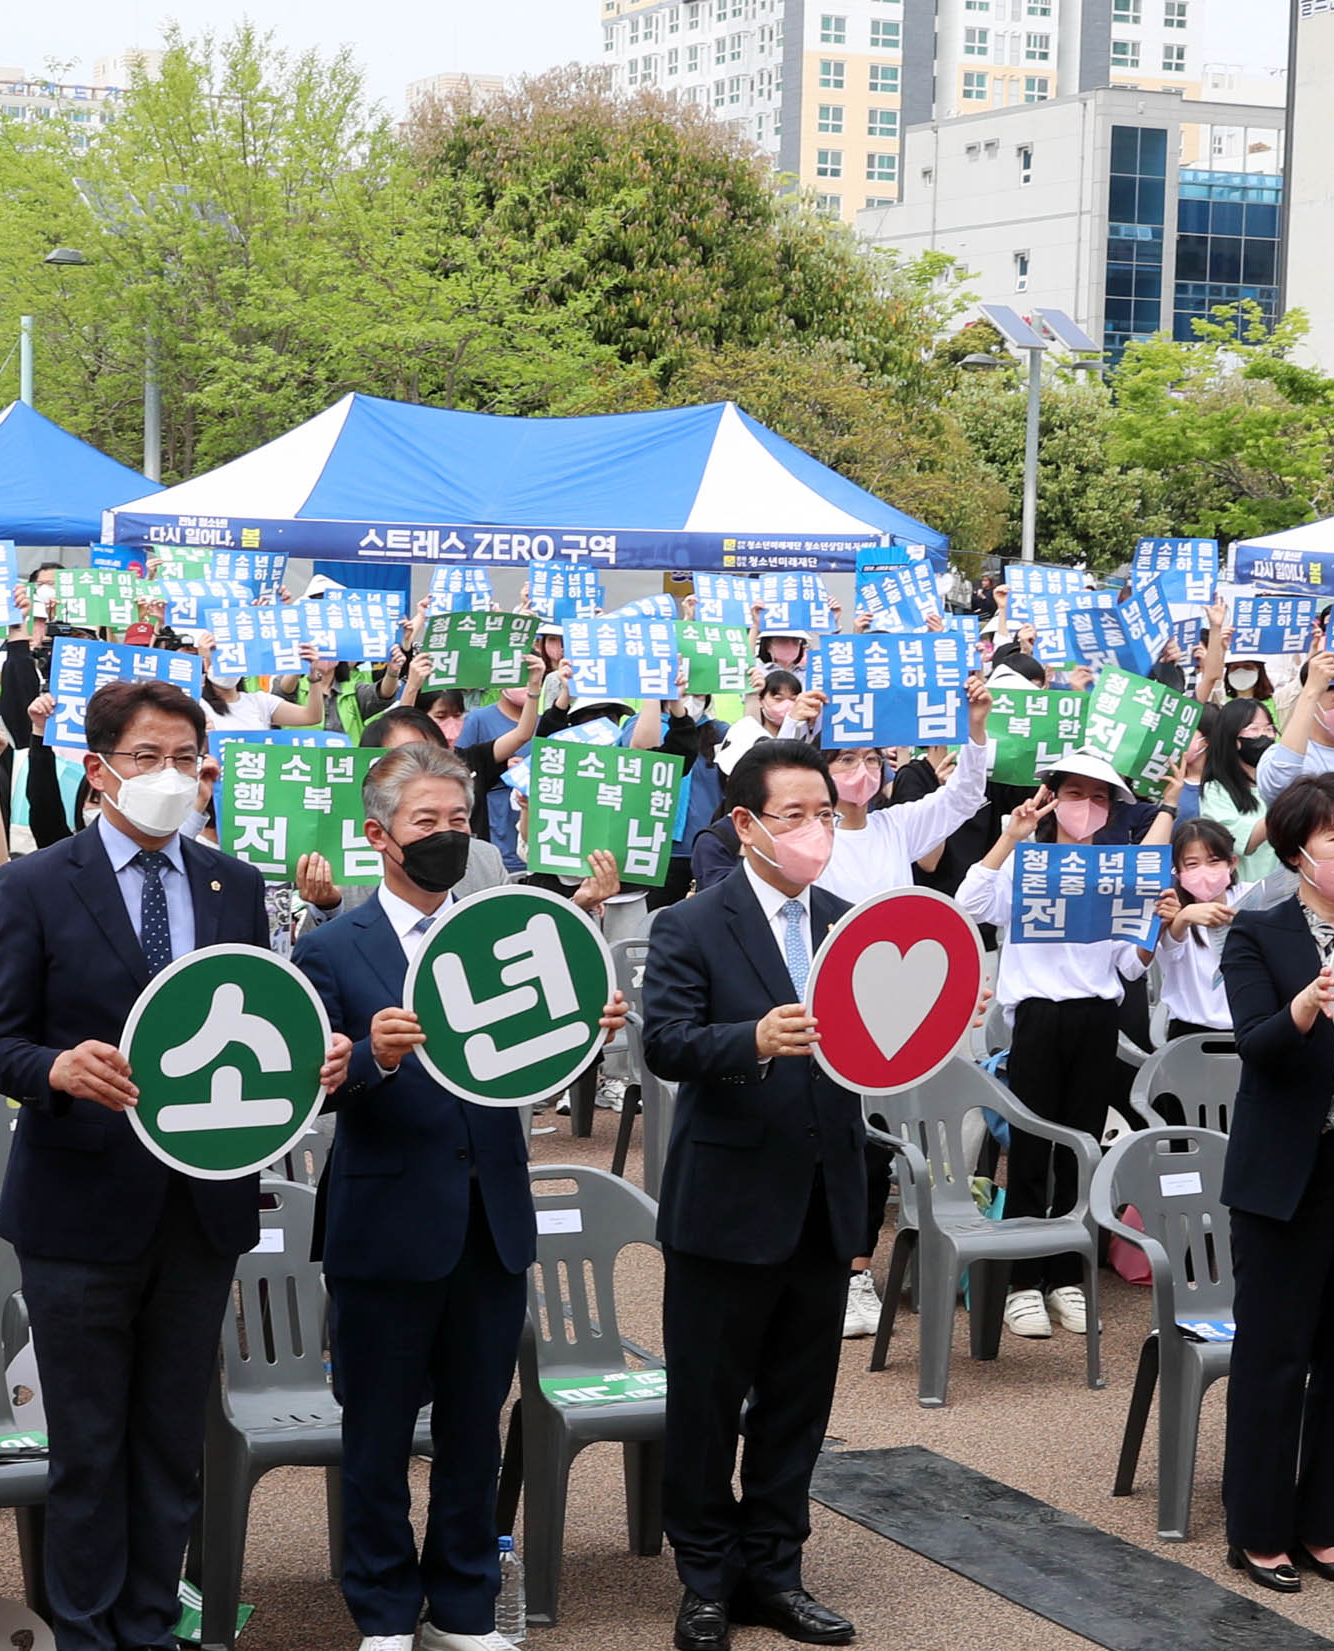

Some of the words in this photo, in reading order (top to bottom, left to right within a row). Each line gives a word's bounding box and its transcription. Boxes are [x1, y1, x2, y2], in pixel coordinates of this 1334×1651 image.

[149, 526, 181, 545] 다시
[184, 528, 236, 547] 일어나,
[241, 528, 261, 549] 봄
[357, 529, 467, 561] 스트레스
[473, 532, 555, 561] ZERO
[561, 534, 617, 564] 구역
[1139, 541, 1214, 559] 청소년을
[216, 553, 285, 569] 청소년을
[748, 555, 818, 569] 청소년미래재단
[1136, 555, 1215, 572] 존중하는
[1253, 561, 1274, 579] 다시
[1308, 562, 1322, 584] 봄
[58, 571, 133, 587] 청소년이
[533, 569, 596, 586] 청소년을
[861, 563, 930, 598] 청소년을
[58, 584, 135, 599] 행복한
[430, 592, 491, 613] 전남
[533, 584, 598, 599] 존중하는
[868, 577, 933, 612] 존중하는
[1031, 594, 1113, 614] 청소년을
[60, 597, 134, 625] 전남
[211, 608, 300, 627] 청소년을
[763, 602, 830, 629] 전남
[1237, 612, 1312, 627] 존중하는
[1238, 600, 1312, 614] 청소년을
[212, 622, 302, 642] 존중하는
[431, 614, 532, 633] 청소년이
[568, 620, 669, 640] 청소년을
[309, 630, 389, 658] 전남
[428, 631, 530, 649] 행복한
[570, 638, 671, 658] 존중하는
[828, 639, 958, 664] 청소년을
[1234, 627, 1311, 652] 전남
[60, 643, 193, 682] 청소년을
[217, 640, 302, 674] 전남
[427, 650, 525, 686] 전남
[573, 657, 672, 695] 전남
[830, 664, 960, 690] 존중하는
[991, 694, 1082, 718] 소년이
[1106, 672, 1199, 727] 청소년이
[831, 690, 961, 742] 전남
[1007, 716, 1082, 740] 복한
[1094, 692, 1193, 749] 행복한
[1085, 714, 1182, 784] 전남
[235, 751, 354, 783] 청소년
[538, 747, 676, 788] 청소년이
[234, 782, 333, 814] 행복
[537, 774, 673, 819] 행복한
[537, 808, 667, 878] 전남
[1021, 849, 1163, 875] 청소년을
[1021, 873, 1163, 897] 존중하는
[1021, 897, 1158, 942] 전남
[431, 914, 591, 1082] 년
[156, 983, 294, 1133] 소
